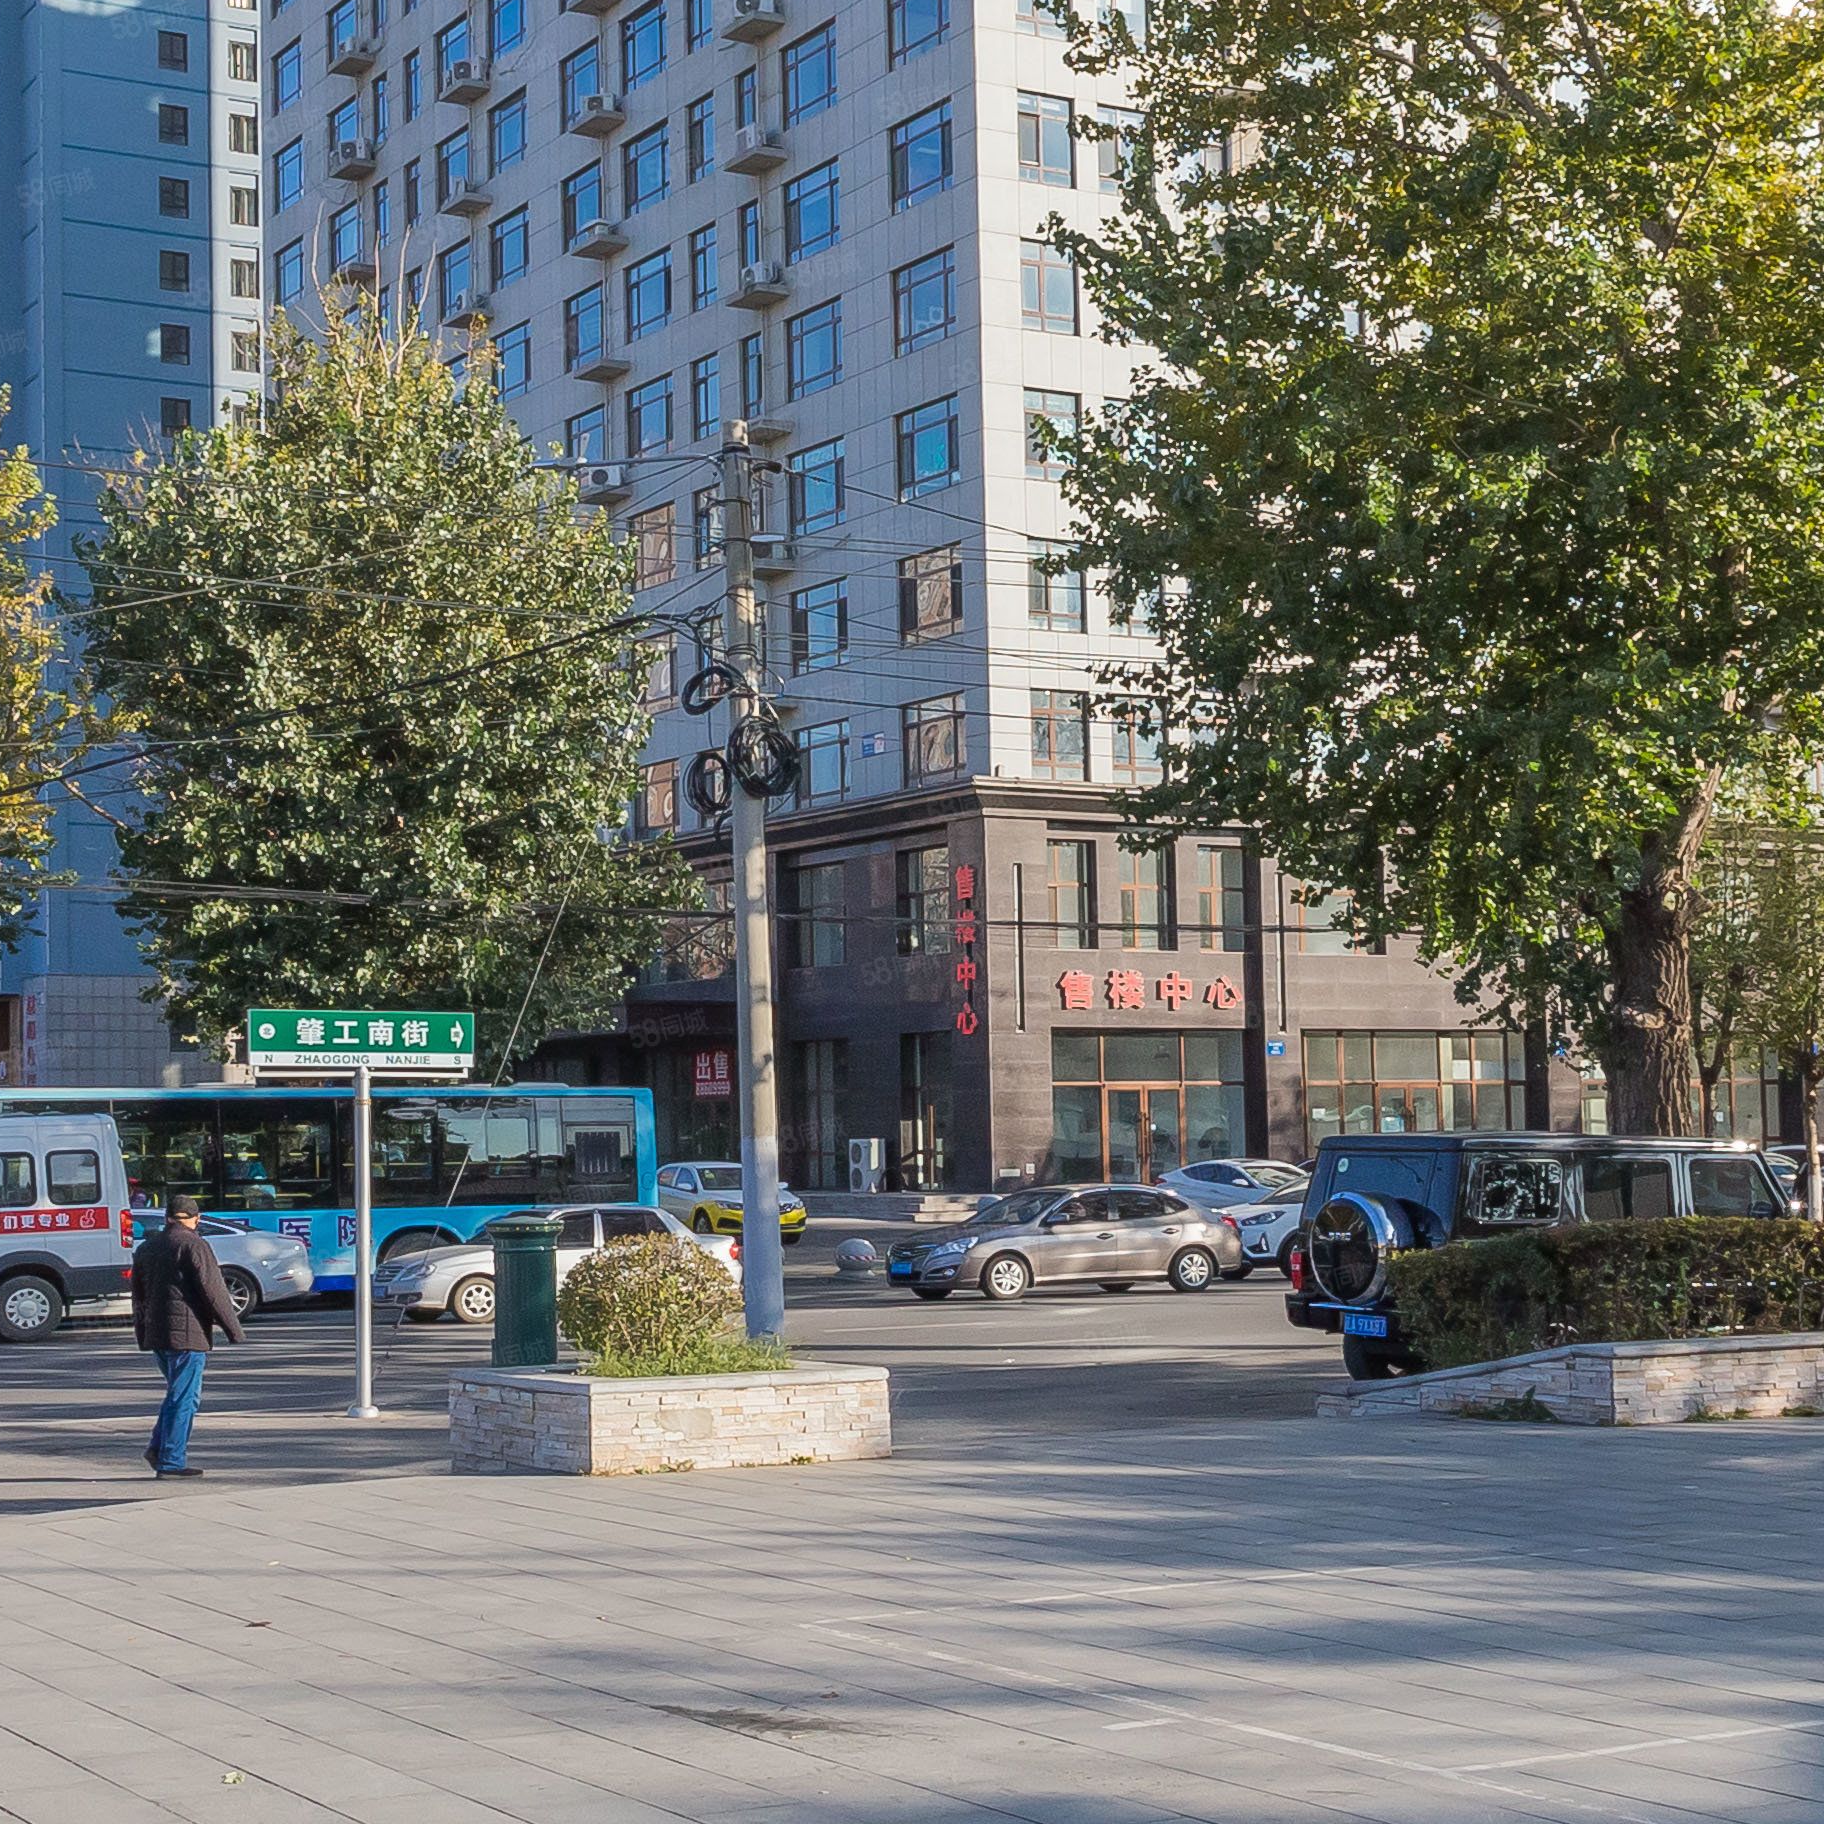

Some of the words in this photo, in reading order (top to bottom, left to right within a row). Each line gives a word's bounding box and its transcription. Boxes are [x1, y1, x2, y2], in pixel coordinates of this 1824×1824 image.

[1057, 969, 1243, 1012] 售楼中心
[296, 1017, 430, 1047] 肇工南街
[264, 1054, 273, 1063] N
[294, 1054, 370, 1065] ZHAOGONG
[385, 1055, 431, 1065] NANJIE
[453, 1056, 462, 1065] S
[696, 1051, 728, 1080] 出售
